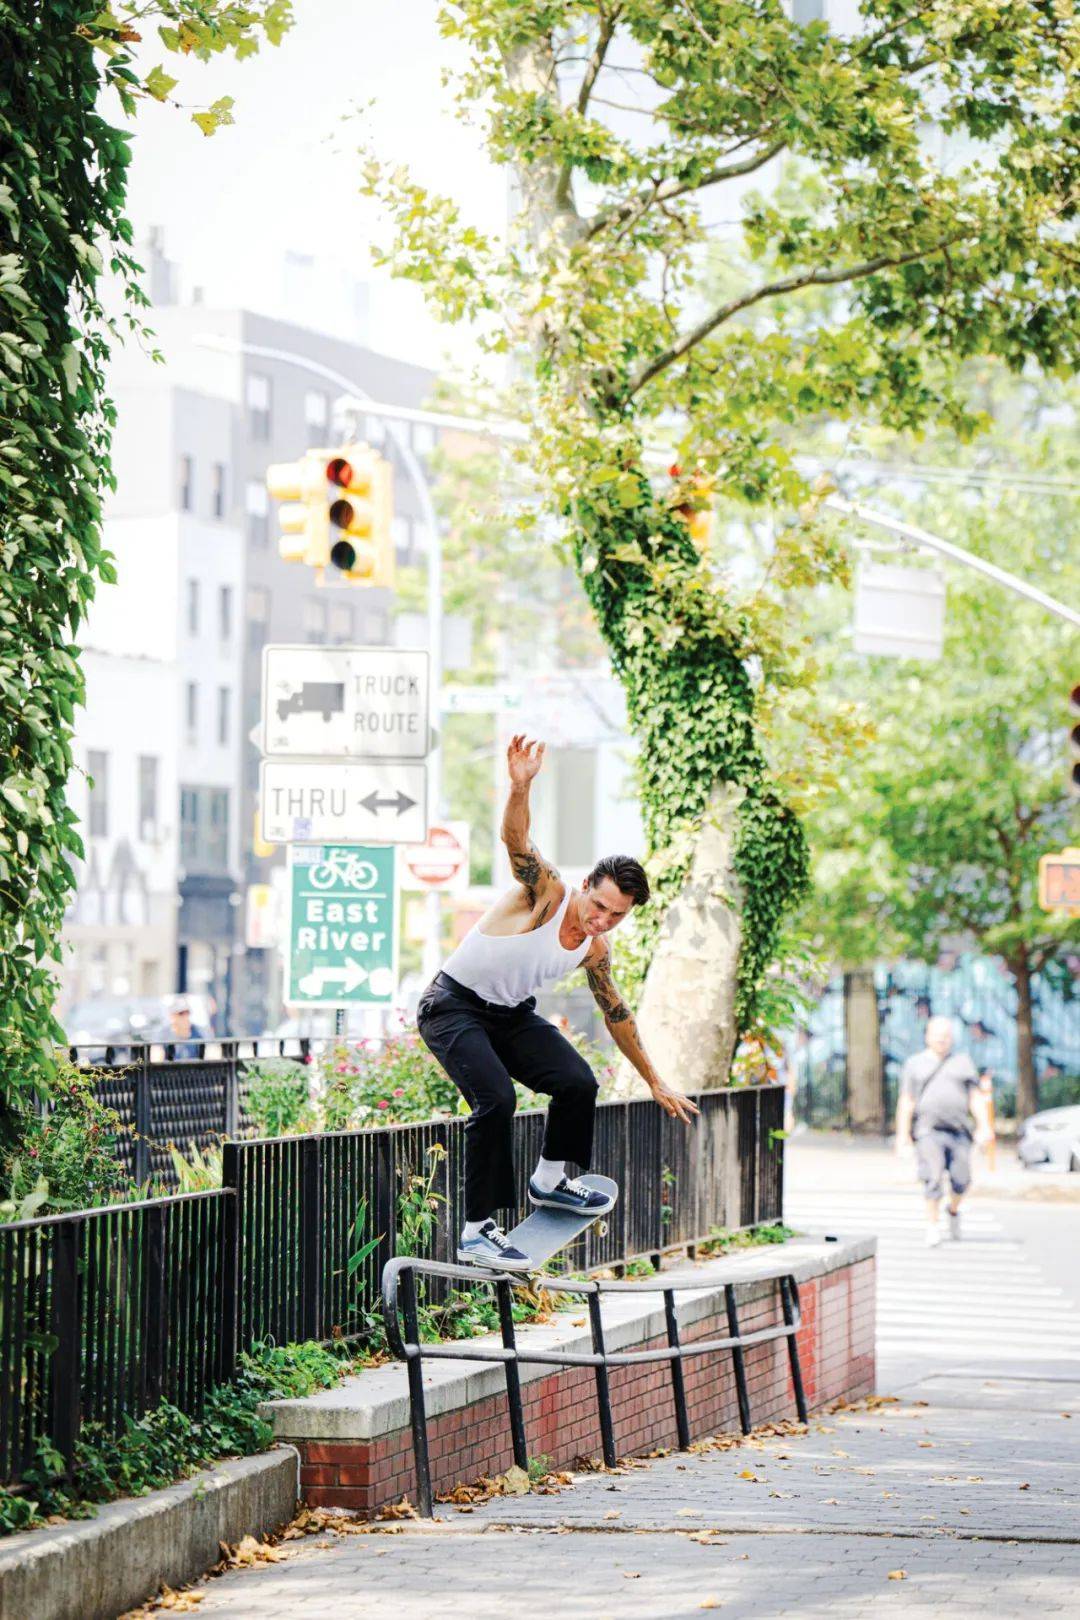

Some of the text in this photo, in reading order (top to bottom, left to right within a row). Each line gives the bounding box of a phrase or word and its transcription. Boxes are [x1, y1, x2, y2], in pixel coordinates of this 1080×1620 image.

[354, 674, 419, 696] TRUCK
[354, 712, 418, 733] ROUTE
[271, 788, 346, 817] THRU
[306, 900, 379, 923] East
[298, 927, 386, 952] River
